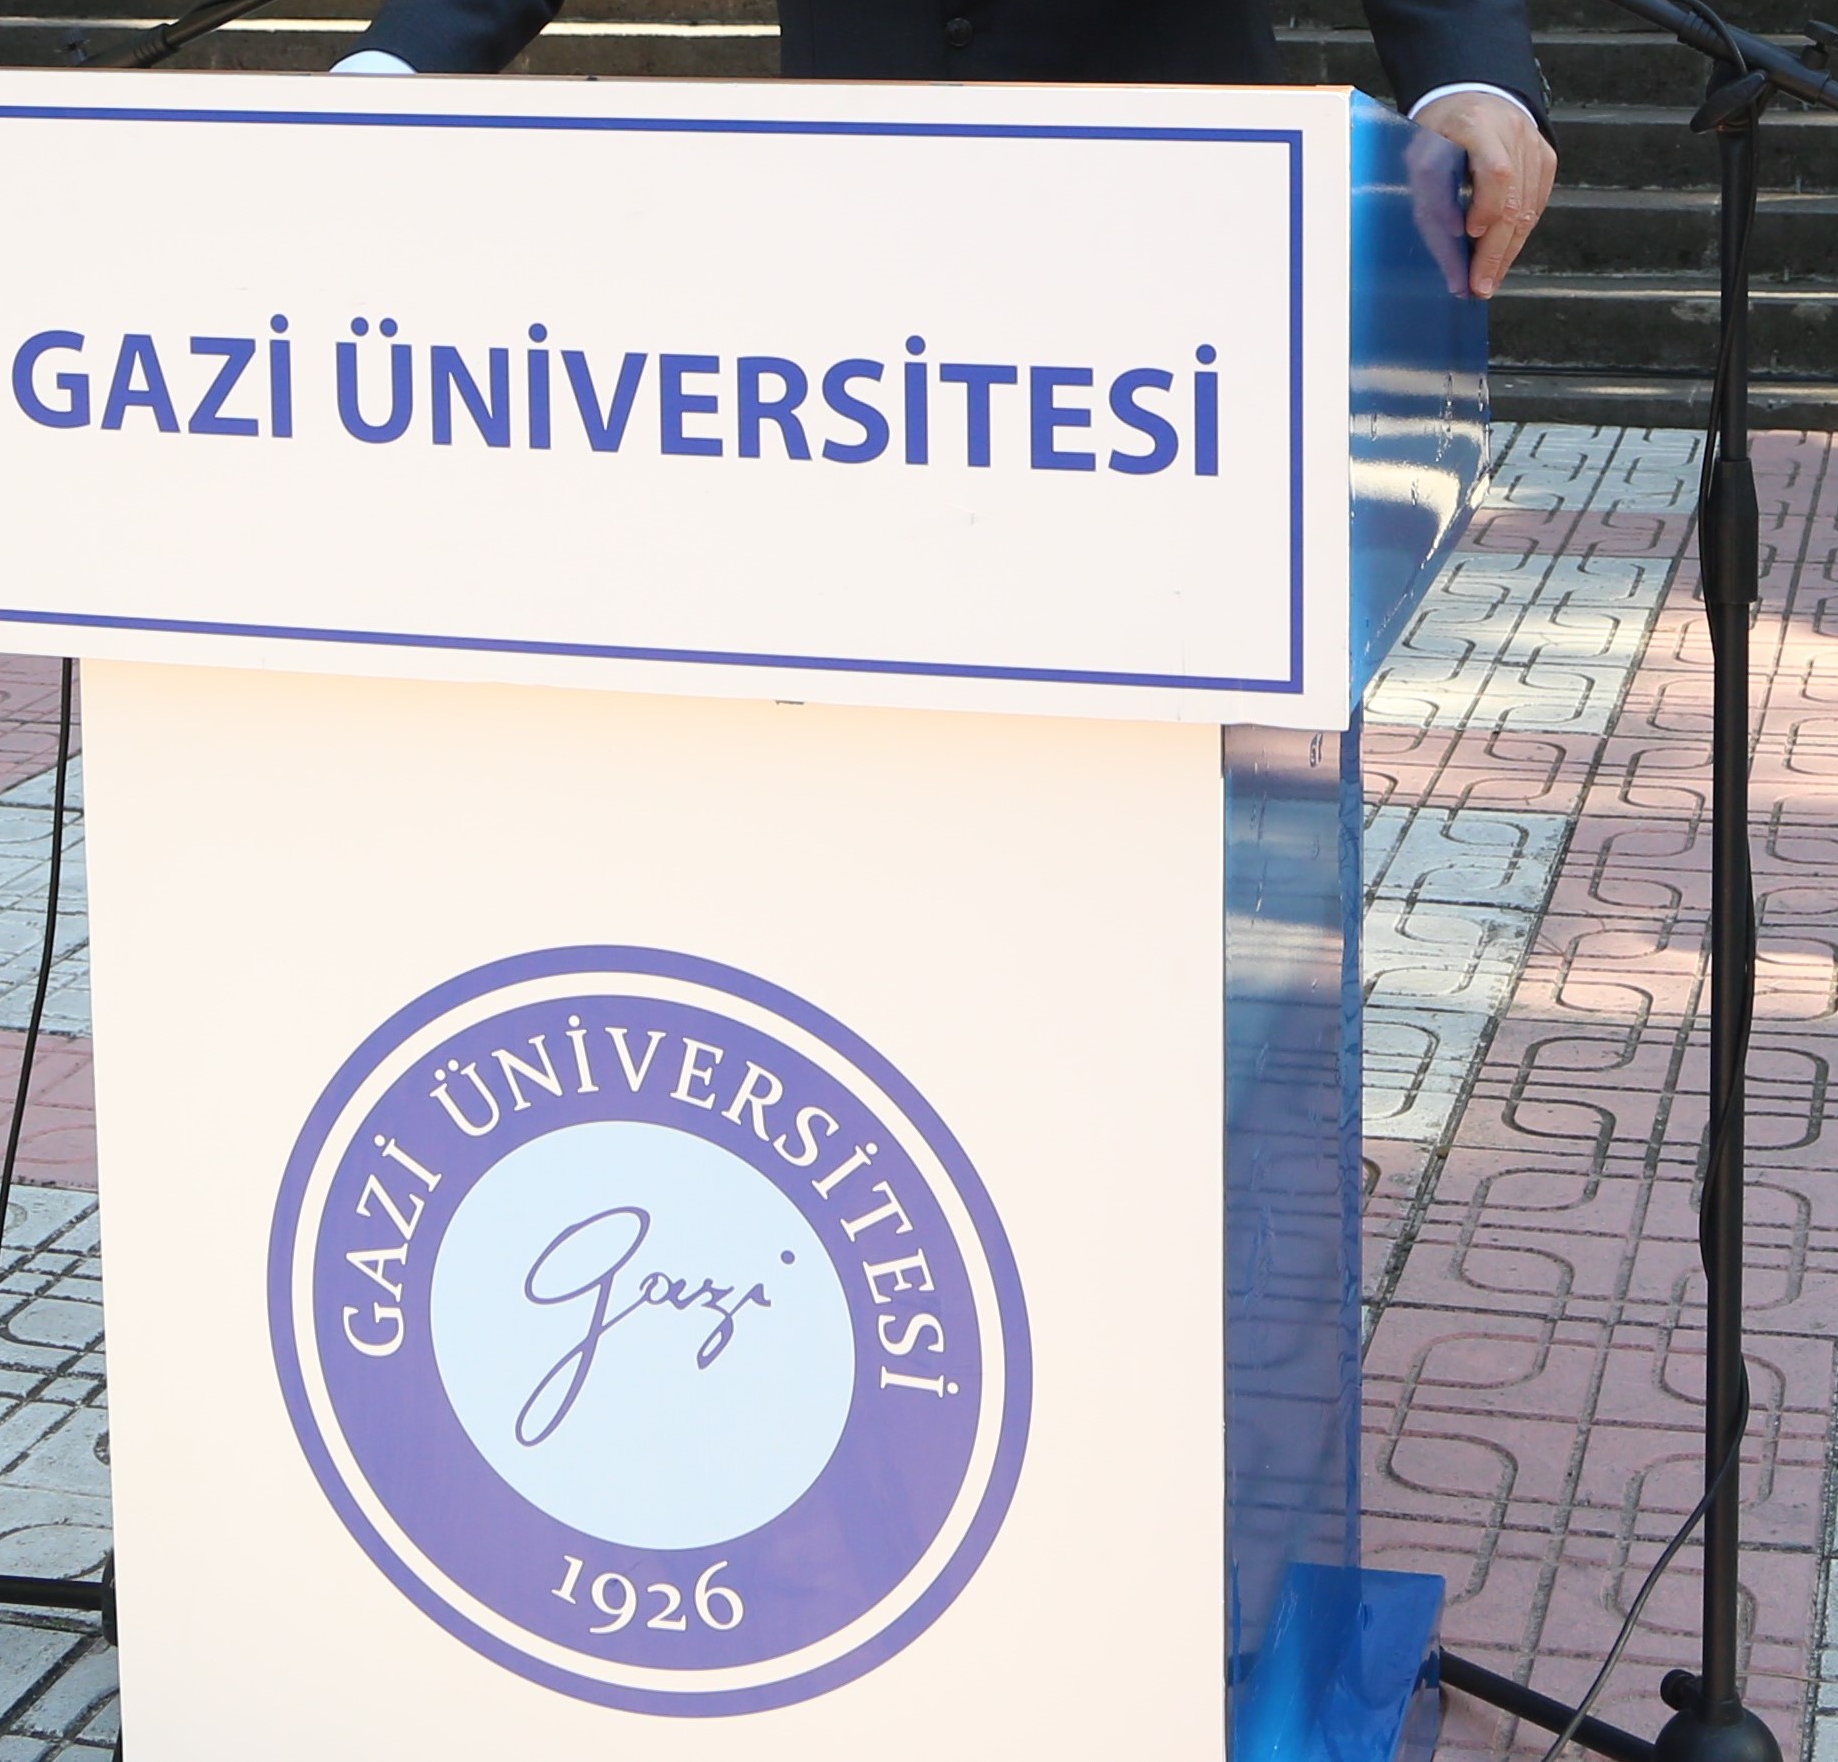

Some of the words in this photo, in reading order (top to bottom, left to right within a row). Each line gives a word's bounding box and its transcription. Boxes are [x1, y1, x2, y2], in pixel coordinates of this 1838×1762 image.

[12, 313, 293, 438] GAZİ
[336, 316, 1221, 478] ÜNİVERSİTESİ
[342, 1133, 443, 1357] GAZİ
[429, 1014, 960, 1399] ÜNİVERSİTESİ
[550, 1554, 745, 1634] 1926
